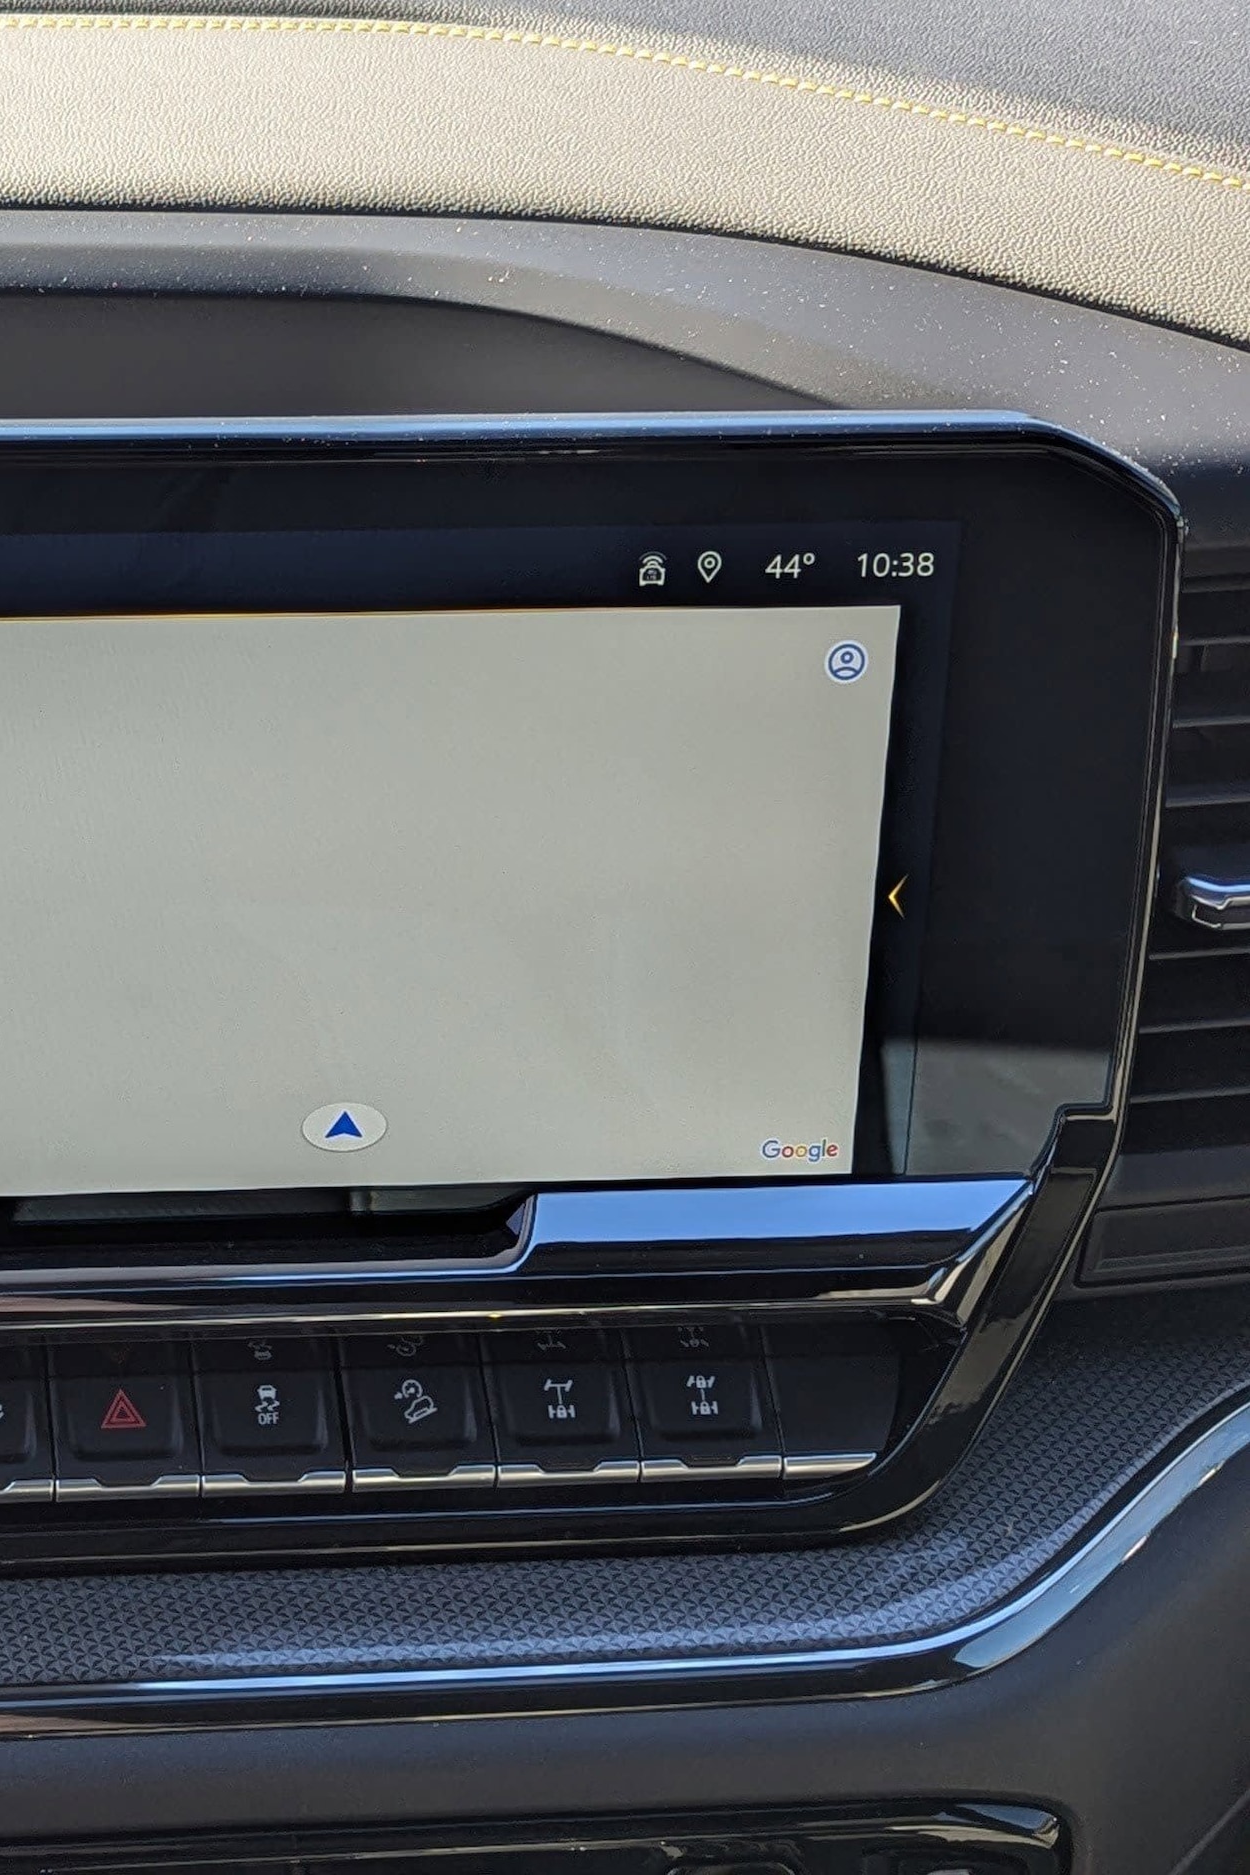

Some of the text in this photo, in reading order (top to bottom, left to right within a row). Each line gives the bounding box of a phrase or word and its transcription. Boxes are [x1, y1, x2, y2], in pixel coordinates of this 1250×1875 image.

[765, 553, 816, 579] 44°
[857, 552, 935, 578] 10:38
[762, 1139, 838, 1163] Google
[258, 1412, 279, 1425] OFF
